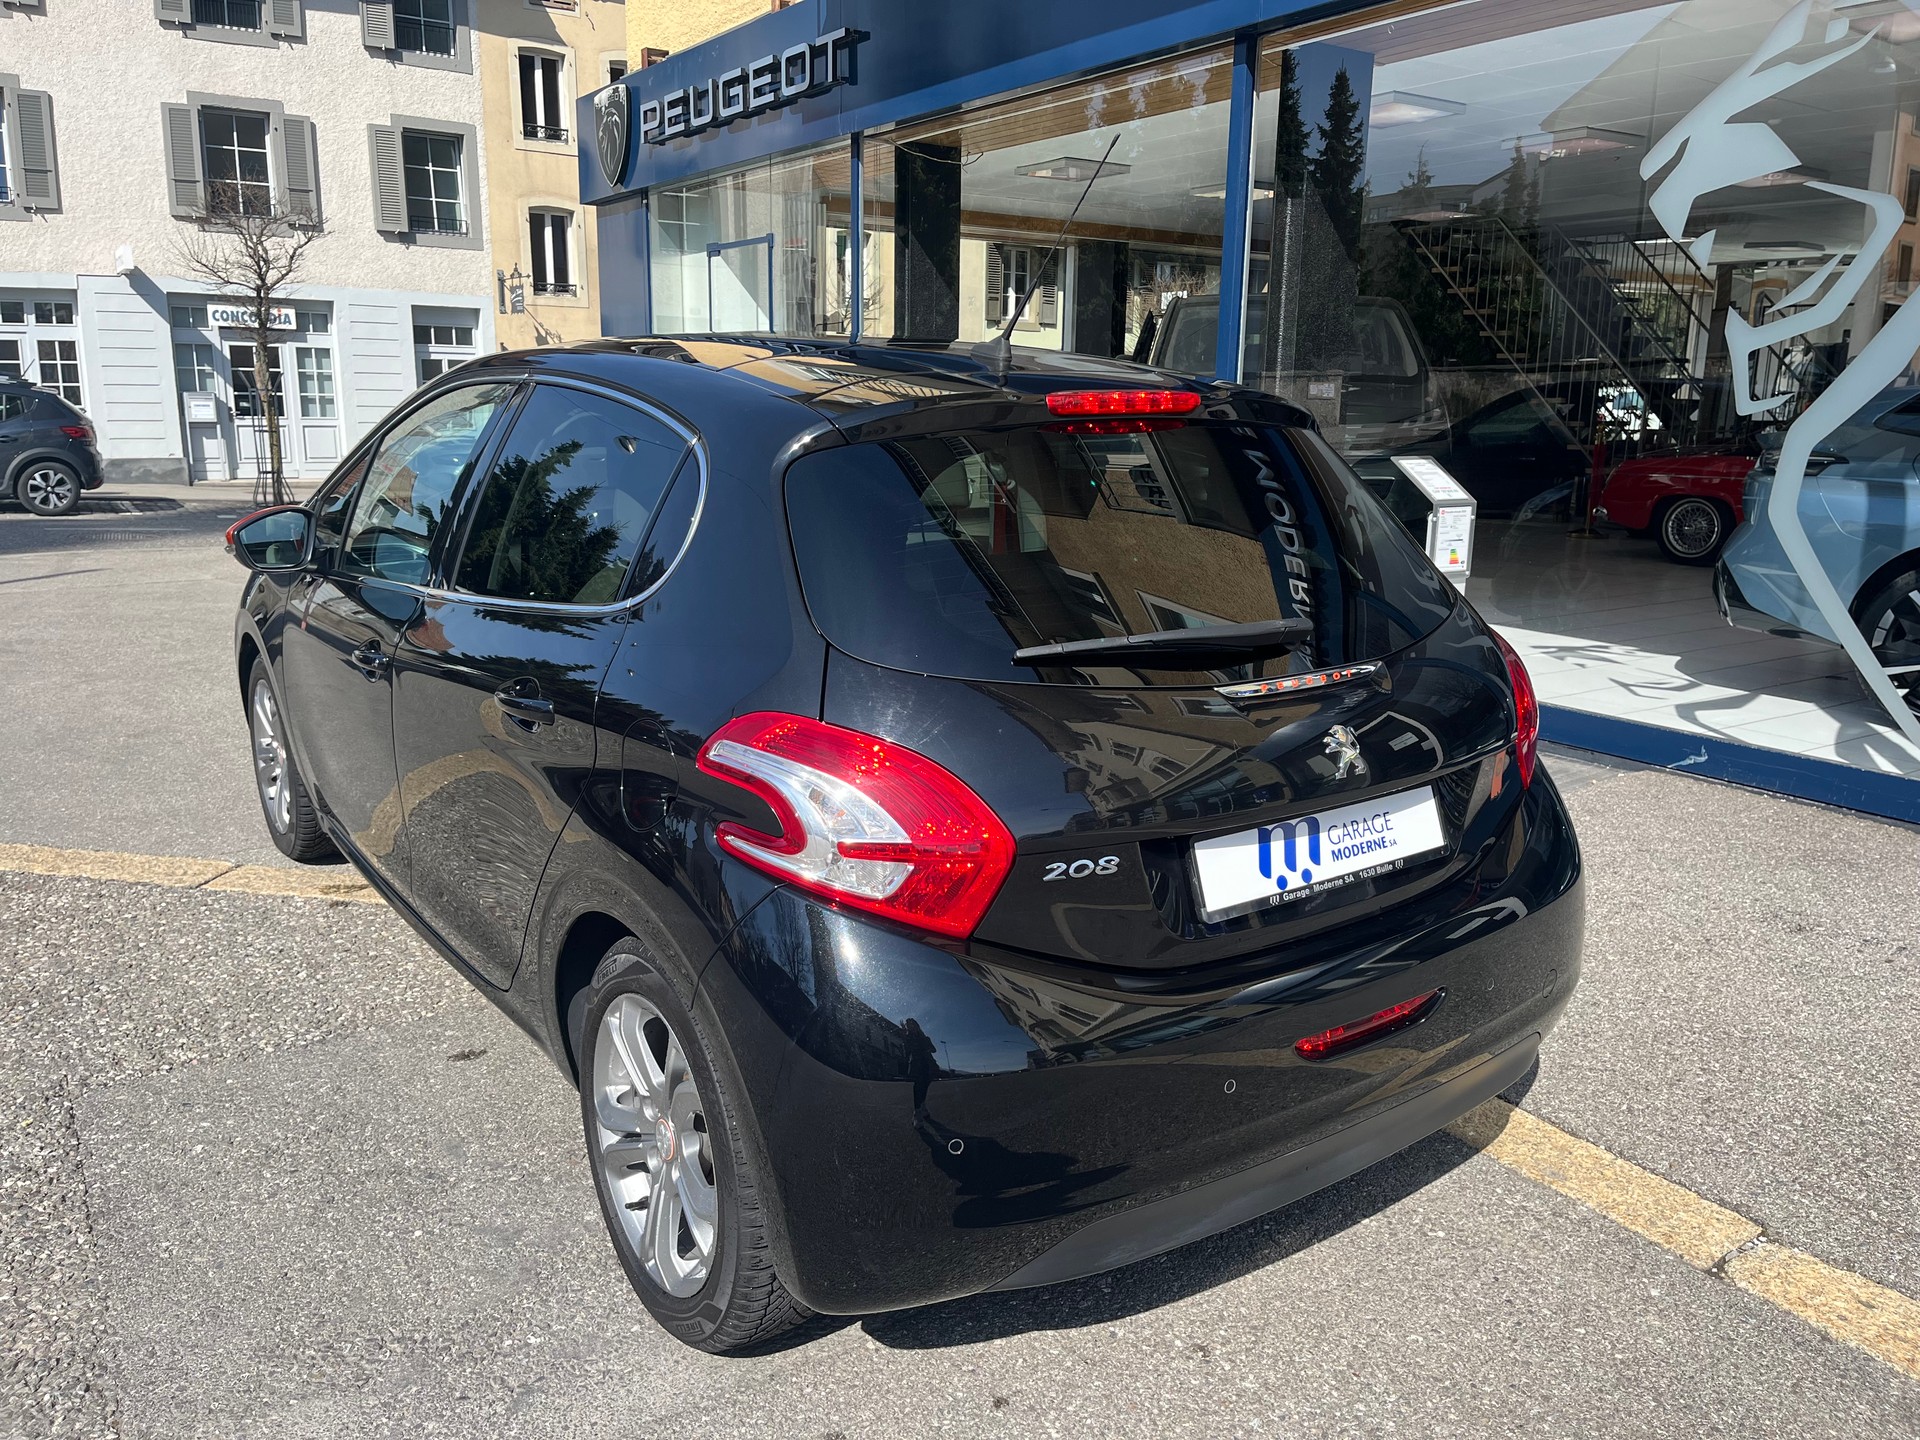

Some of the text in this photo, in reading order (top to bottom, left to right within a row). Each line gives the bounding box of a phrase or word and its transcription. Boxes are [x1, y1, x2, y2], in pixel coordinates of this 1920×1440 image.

[639, 26, 848, 144] PEUGEOT
[211, 307, 292, 325] CONCODIA
[1260, 669, 1352, 694] PEUGEOT
[1327, 811, 1394, 846] GARAGE
[1331, 836, 1398, 863] MODERNE SA
[1042, 855, 1120, 882] 208
[1282, 889, 1310, 901] Garage
[1313, 879, 1344, 893] Moderne
[1344, 874, 1355, 883] SA
[1359, 868, 1376, 879] 1630
[1376, 863, 1393, 874] Bulle
